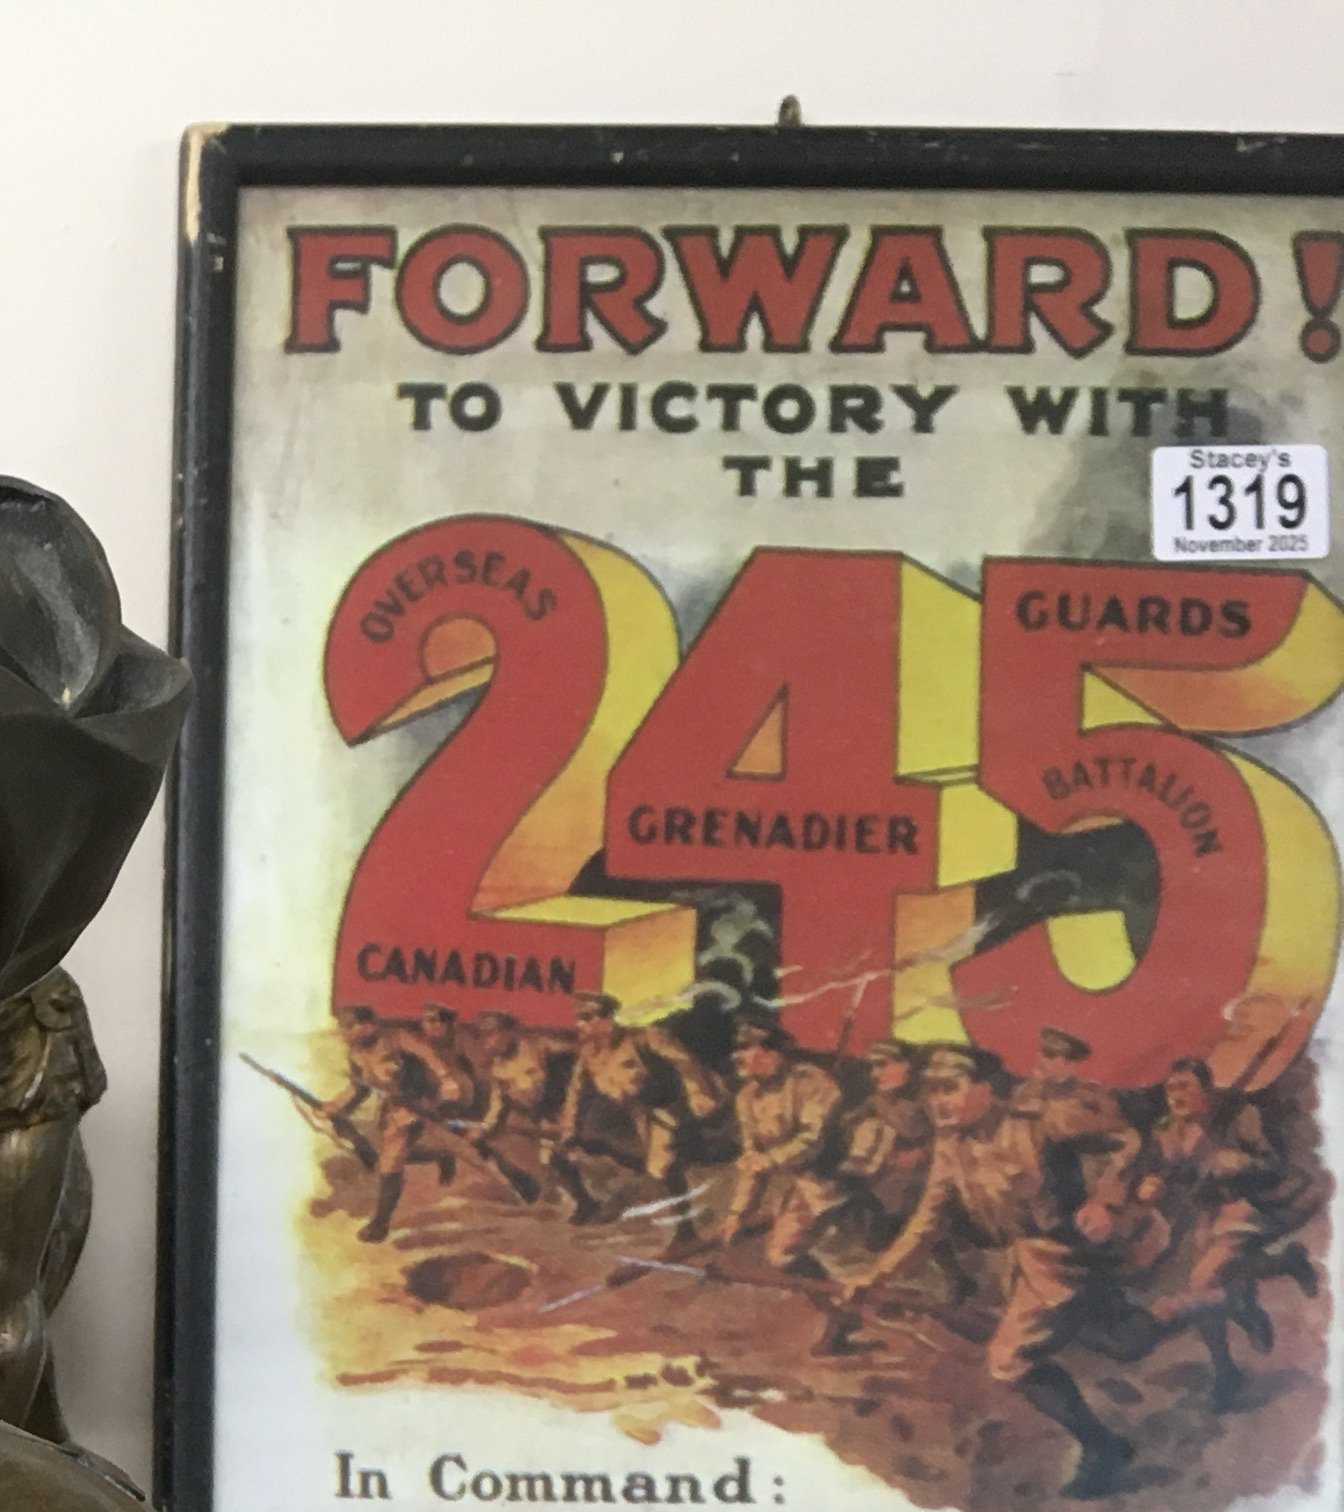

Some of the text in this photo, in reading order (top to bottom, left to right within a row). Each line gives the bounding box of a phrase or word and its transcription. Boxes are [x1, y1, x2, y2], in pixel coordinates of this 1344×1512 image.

[397, 382, 1230, 438] TO VICTORY WITH
[722, 456, 905, 500] THE
[1189, 449, 1292, 473] Stacey's
[1172, 473, 1308, 531] 1319
[1173, 533, 1310, 554] November 2025
[359, 549, 559, 644] OVERSEAS
[1015, 590, 1254, 640] GUARDS
[322, 512, 1344, 1095] 245
[626, 803, 921, 857] GRENADIER
[1041, 756, 1226, 859] BATTALION
[356, 941, 577, 996] CANADIAN
[334, 1450, 392, 1500] In
